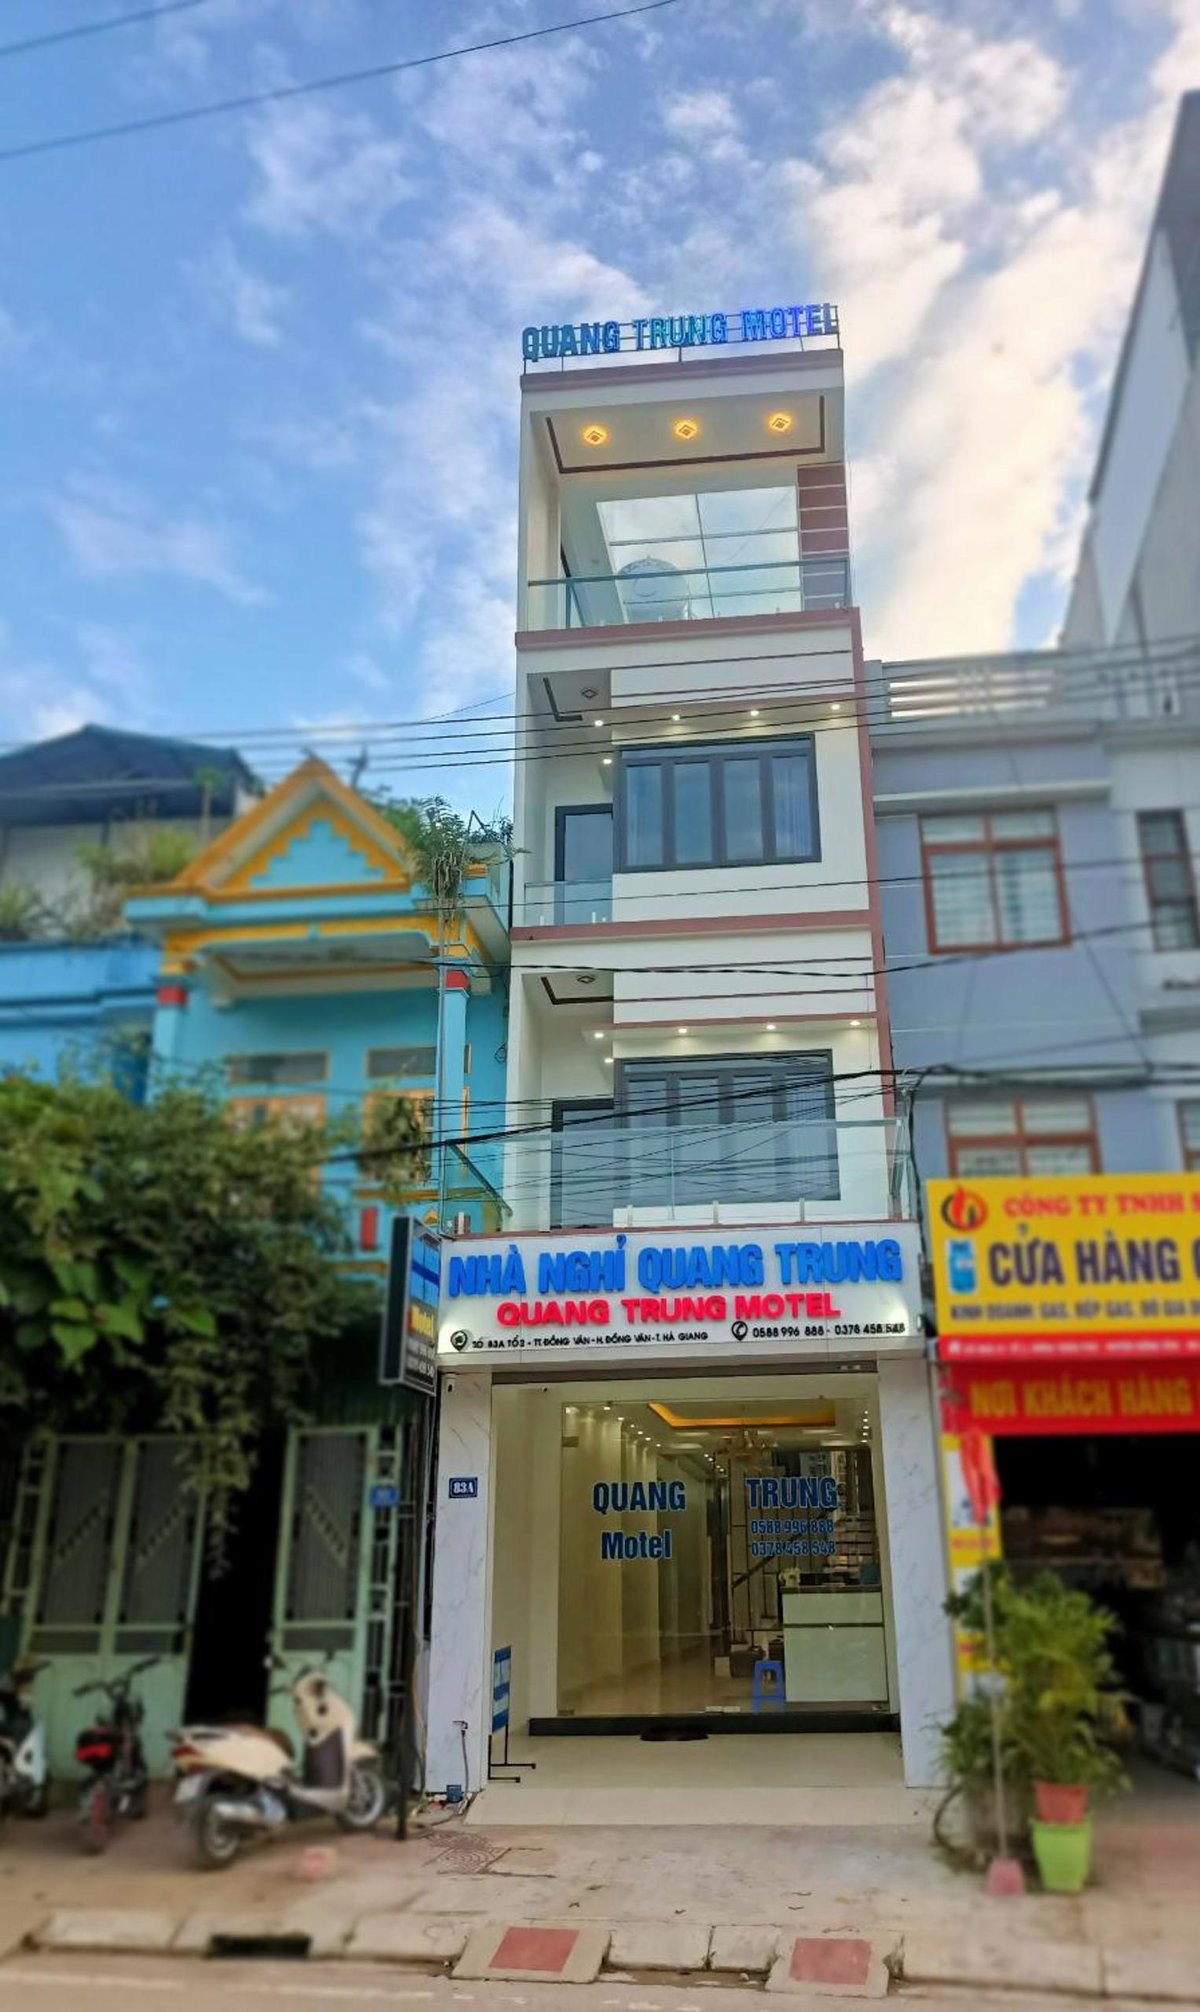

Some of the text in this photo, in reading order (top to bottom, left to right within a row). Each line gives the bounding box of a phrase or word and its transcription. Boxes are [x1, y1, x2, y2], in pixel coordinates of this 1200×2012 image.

[522, 302, 839, 362] QUANG TRUNG MOTEL
[1078, 1195, 1108, 1217] TY
[1115, 1193, 1185, 1215] TNHH
[450, 1244, 527, 1297] NHÀ
[538, 1234, 626, 1295] NGHỈ
[637, 1244, 765, 1295] QUANG
[775, 1239, 904, 1285] TRUNG
[988, 1223, 1065, 1286] CỬA
[1075, 1230, 1181, 1284] HÀNG
[496, 1292, 842, 1327] QUANG TRUNG MOTEL
[678, 1331, 709, 1341] GIANG
[752, 1327, 779, 1338] 0588
[782, 1326, 800, 1336] 996
[804, 1325, 824, 1336] 888
[593, 1481, 685, 1512] QUANG
[746, 1477, 838, 1510] TRUNG
[751, 1519, 834, 1534] 0588 996 888
[601, 1530, 671, 1560] Motel
[751, 1541, 782, 1556] 0378
[785, 1541, 808, 1555] 458
